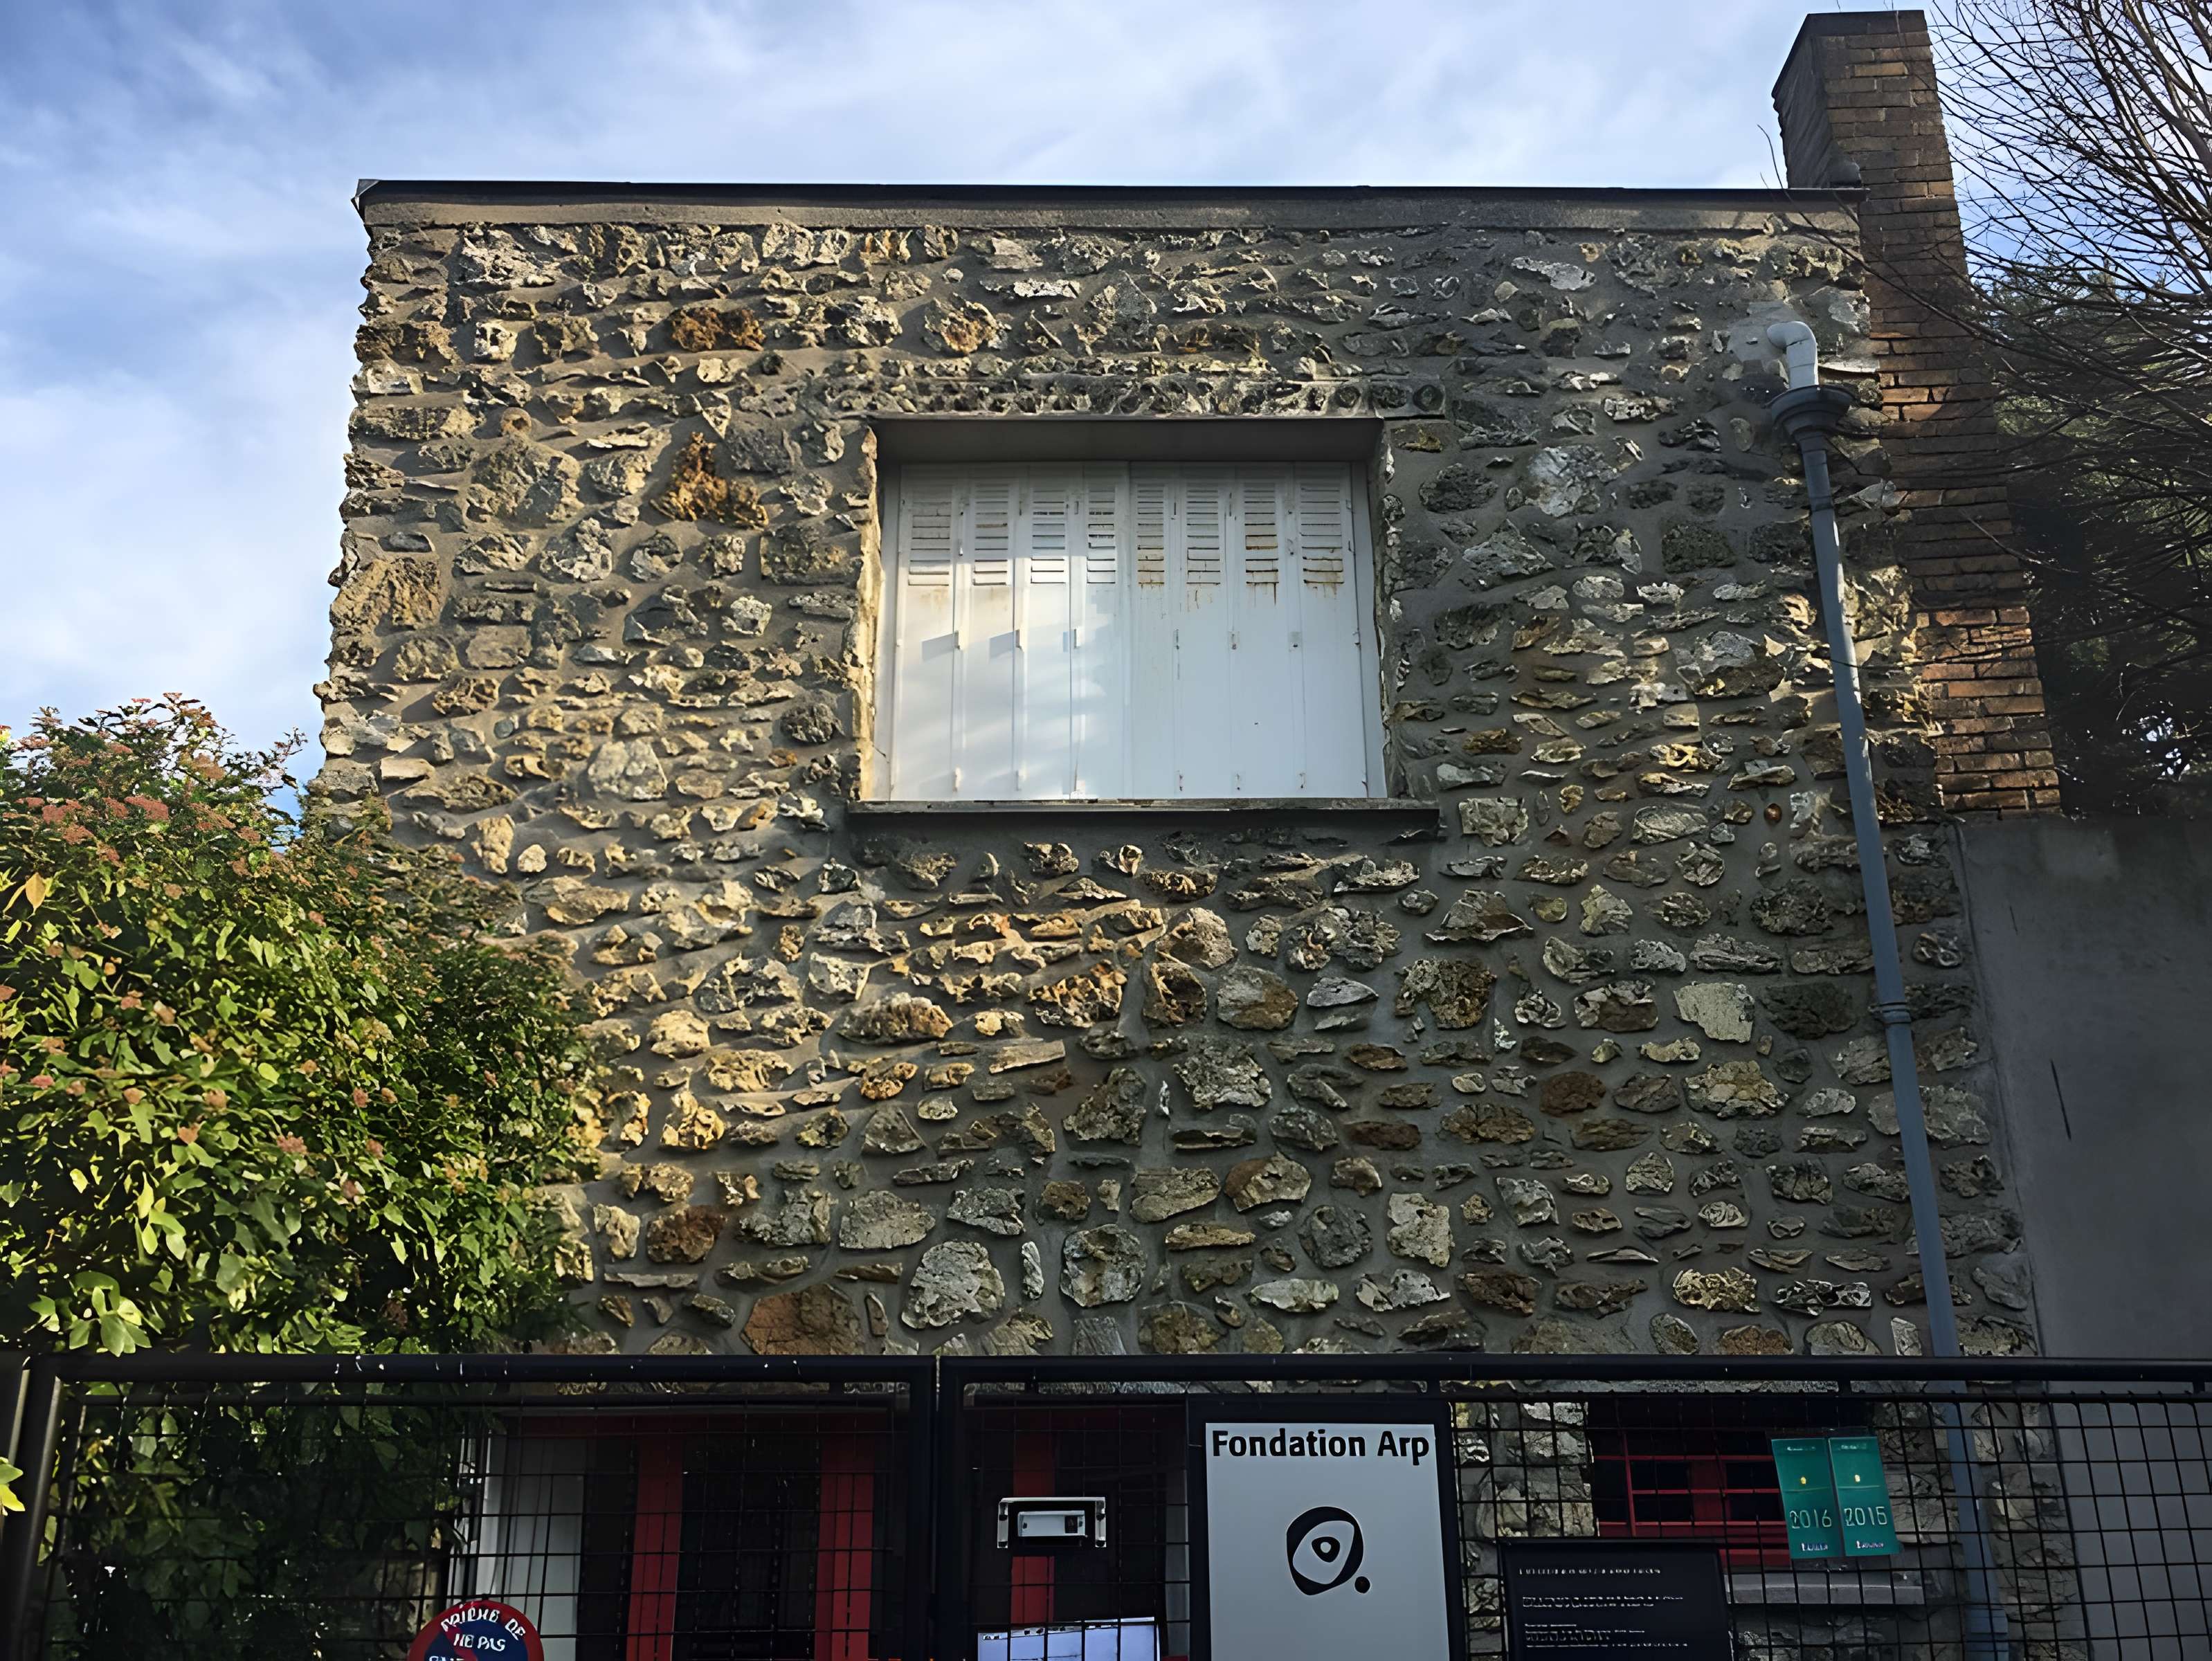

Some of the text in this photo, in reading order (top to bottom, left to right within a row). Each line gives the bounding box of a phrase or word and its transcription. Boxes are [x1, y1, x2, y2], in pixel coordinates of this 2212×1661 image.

[1212, 1428, 1429, 1466] Fondation Arp
[1789, 1509, 1832, 1529] 2016
[1843, 1506, 1888, 1527] 2015
